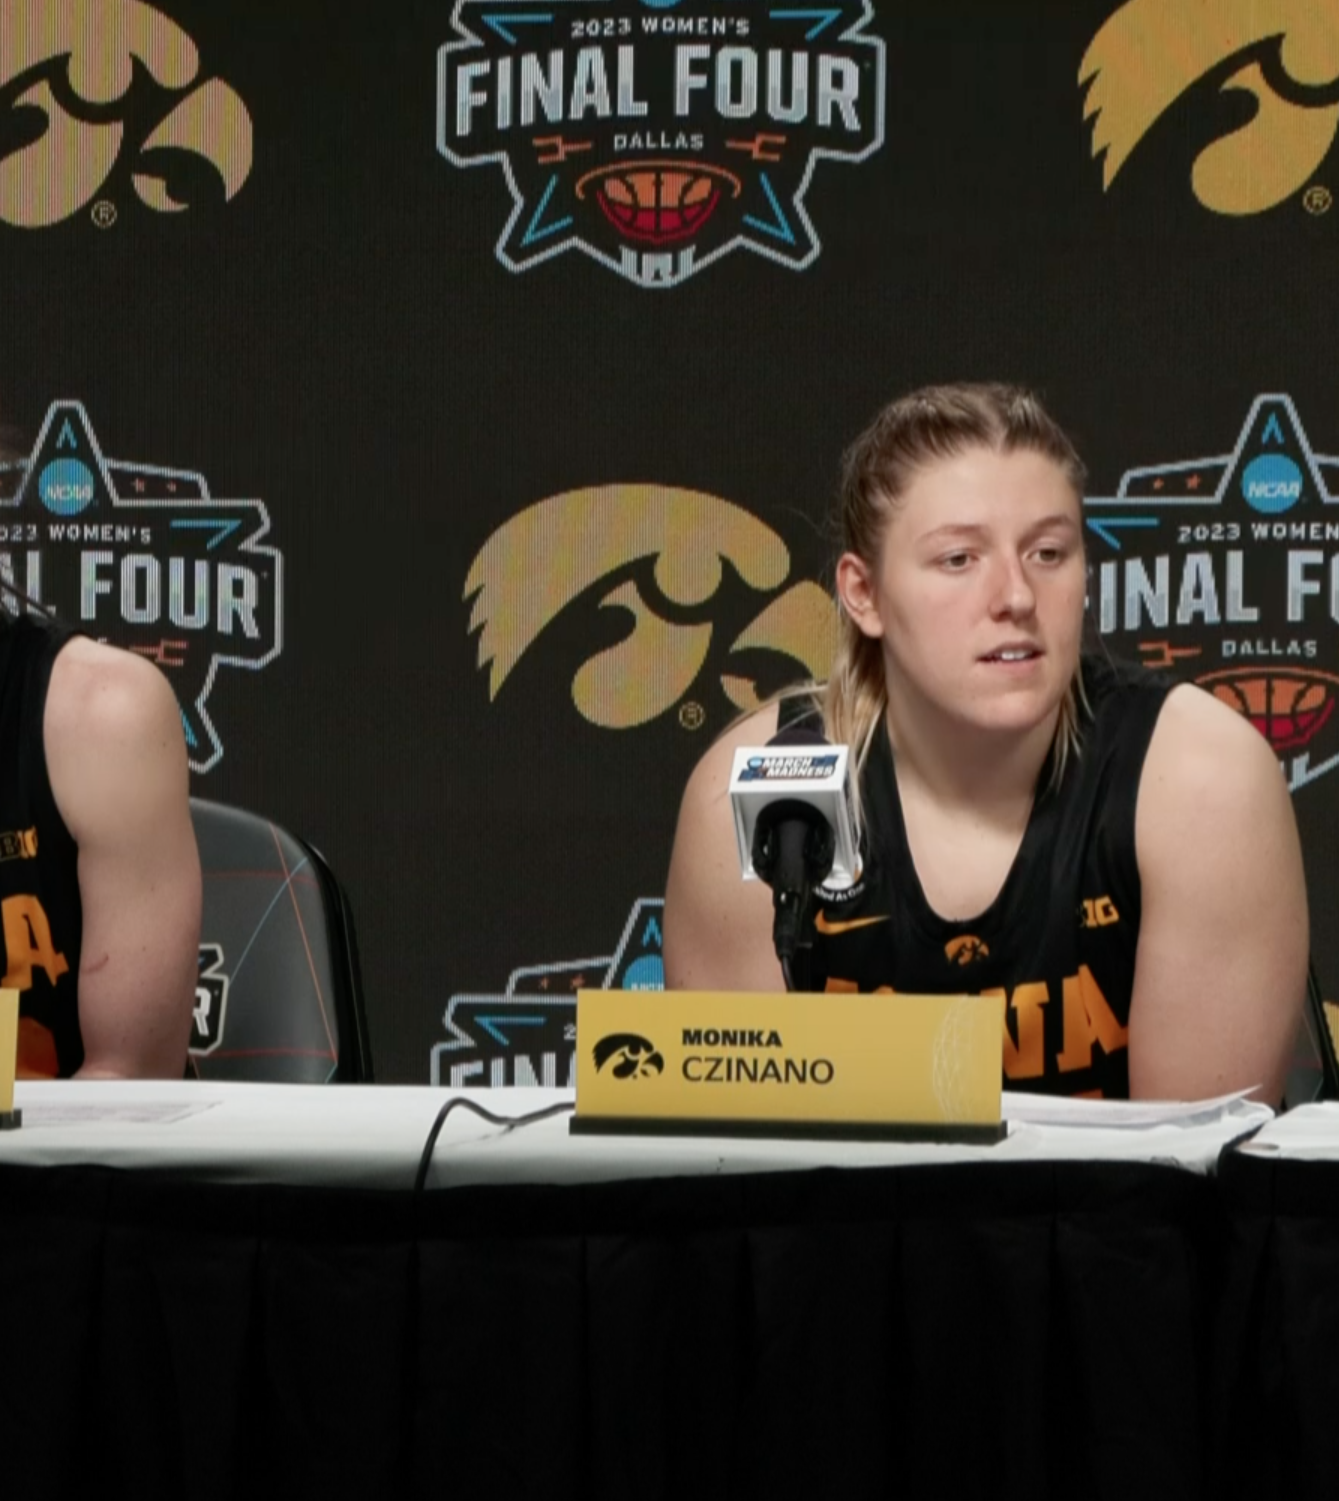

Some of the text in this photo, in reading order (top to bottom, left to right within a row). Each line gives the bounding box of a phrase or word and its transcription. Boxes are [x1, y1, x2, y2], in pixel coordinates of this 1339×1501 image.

[570, 16, 750, 37] 2023 WOMEN'S
[455, 43, 862, 137] FINAL FOUR
[613, 132, 704, 151] DALLAS
[1248, 481, 1301, 499] NCAA
[48, 523, 152, 545] WOMEN'S
[1177, 522, 1241, 544] 2023
[80, 550, 261, 639] FOUR
[1084, 549, 1260, 635] INAL
[1221, 639, 1318, 657] DALLAS
[763, 756, 813, 769] MARCH
[766, 765, 834, 778] MADNESS
[681, 1028, 783, 1048] MONIKA
[681, 1056, 835, 1085] CZINANO
